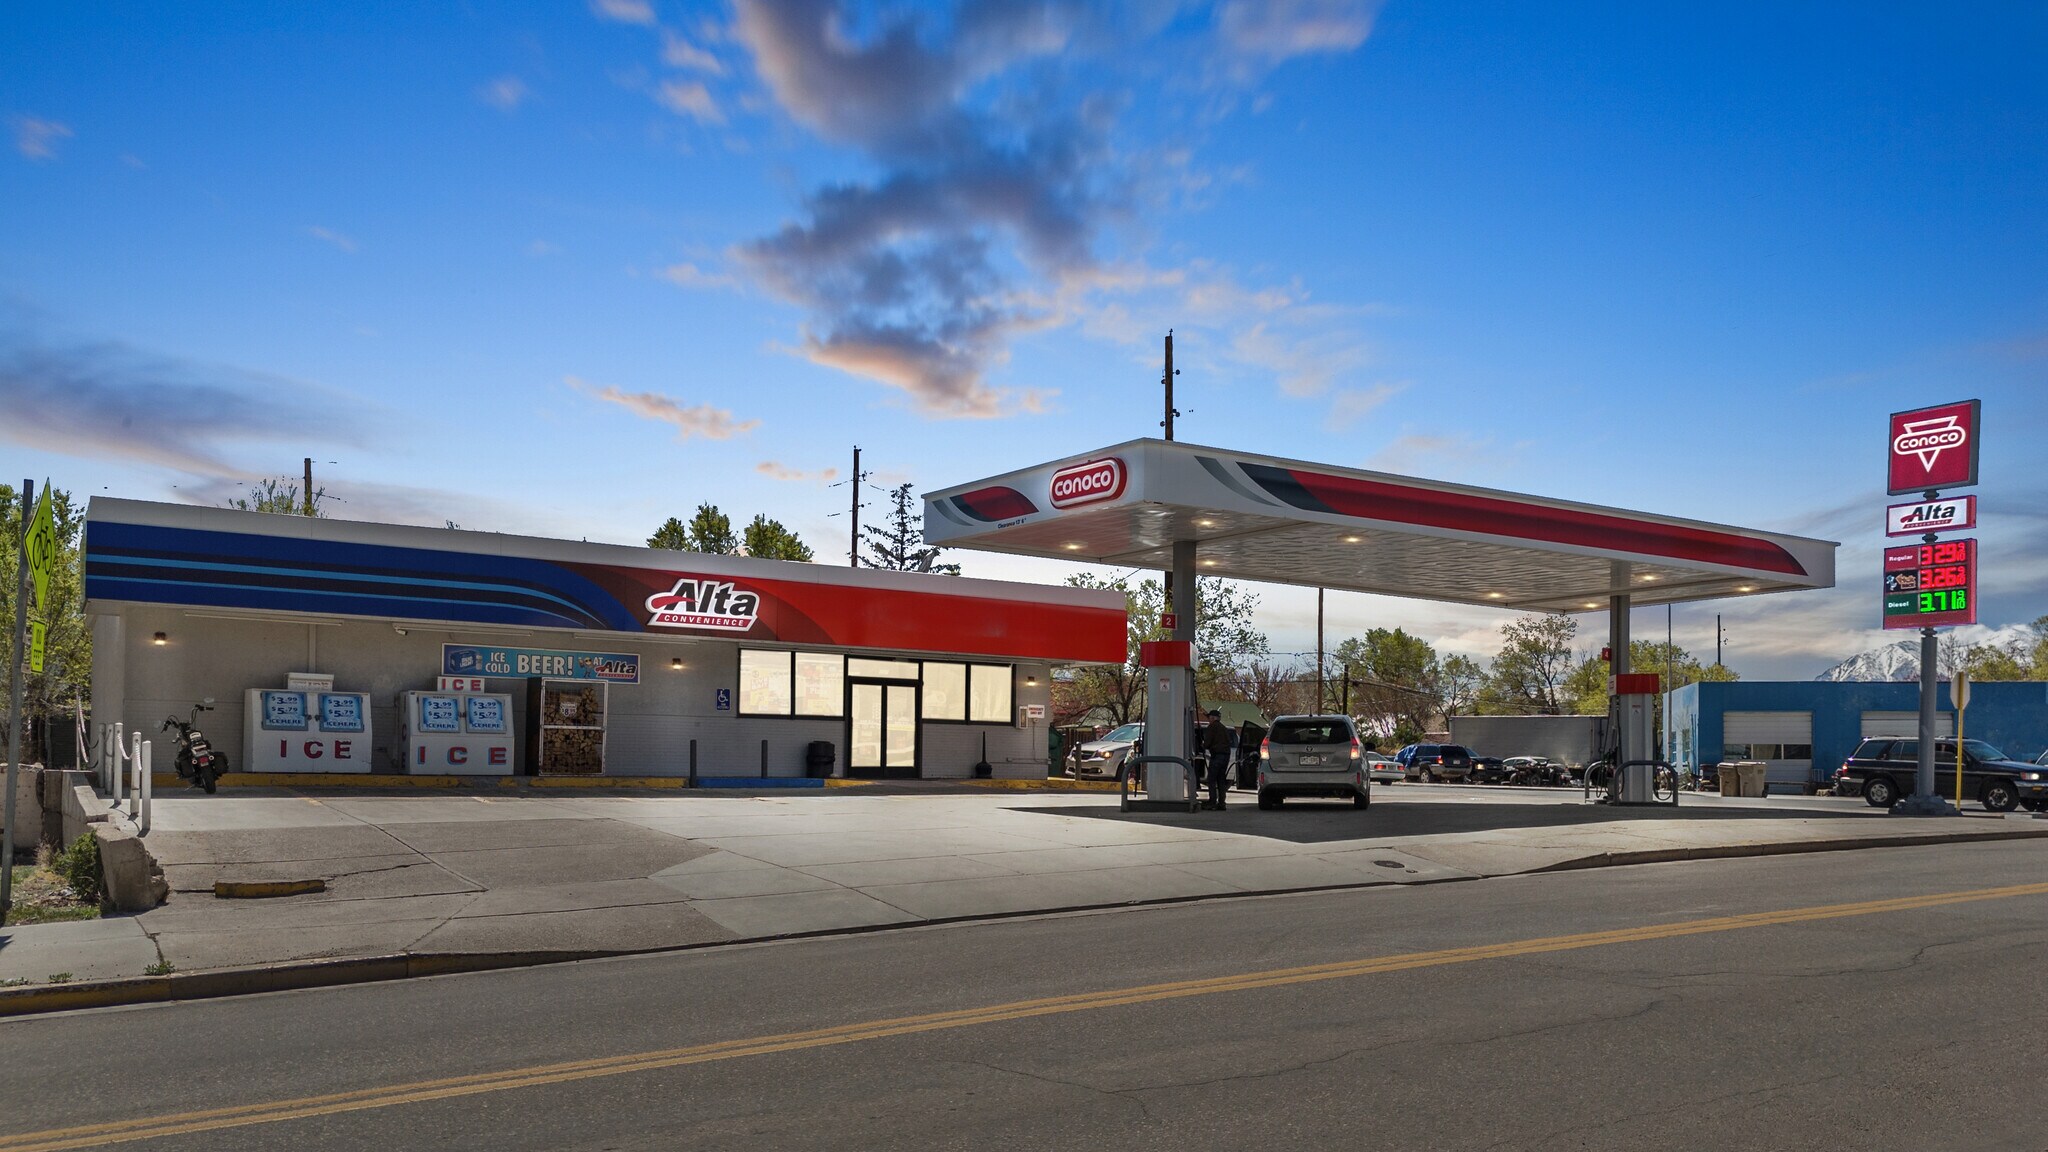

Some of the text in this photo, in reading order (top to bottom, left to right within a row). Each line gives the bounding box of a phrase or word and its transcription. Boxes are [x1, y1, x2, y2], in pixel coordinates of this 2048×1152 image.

[1900, 504, 1956, 523] Alta
[1888, 554, 1914, 562] Regular
[652, 582, 757, 617] Alta
[664, 614, 745, 627] CONVENIENCE
[1166, 617, 1172, 626] 2
[490, 652, 506, 662] ICE
[593, 656, 604, 666] AT
[485, 662, 510, 674] COLD
[517, 654, 573, 676] BEER!
[595, 660, 636, 674] Alta
[441, 678, 482, 692] ICE
[280, 739, 352, 760] ICE
[417, 745, 507, 766] ICE
